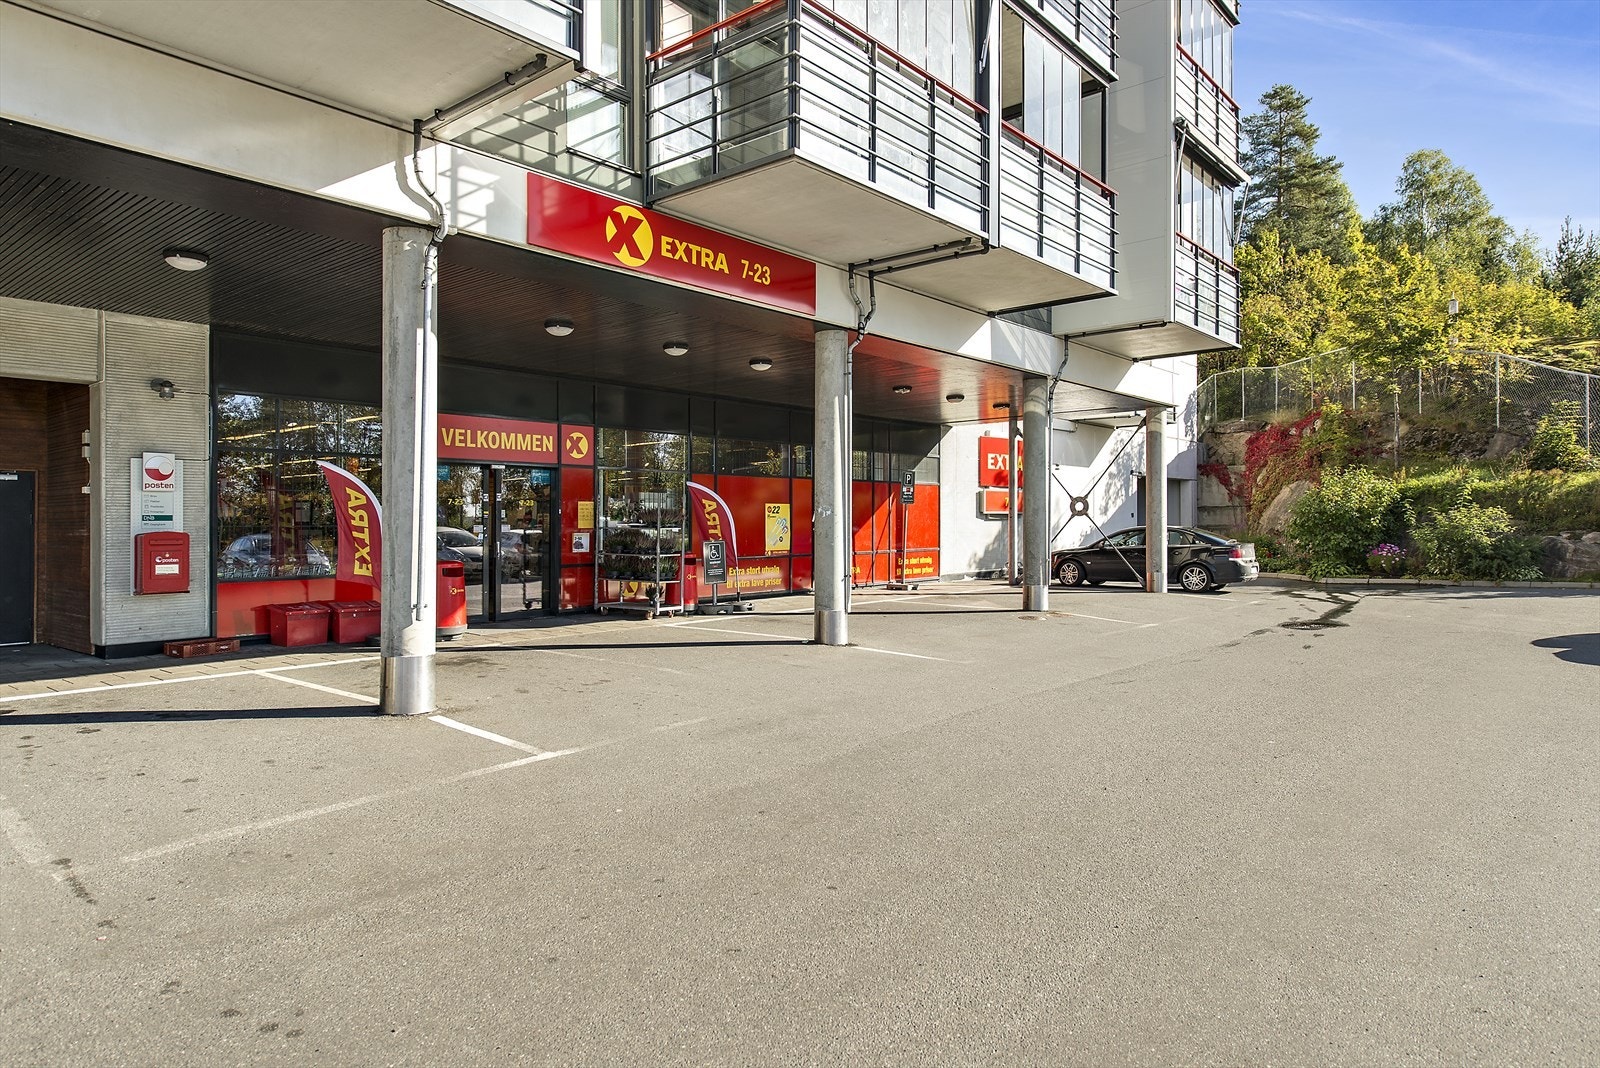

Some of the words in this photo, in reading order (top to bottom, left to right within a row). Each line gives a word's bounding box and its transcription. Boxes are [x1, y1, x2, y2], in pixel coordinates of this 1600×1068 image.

[661, 235, 729, 274] EXTRA
[740, 259, 771, 285] 7-23
[441, 427, 553, 452] VELKOMMEN
[987, 453, 1023, 471] EXTA
[772, 506, 781, 514] 22
[728, 567, 745, 576] Exra
